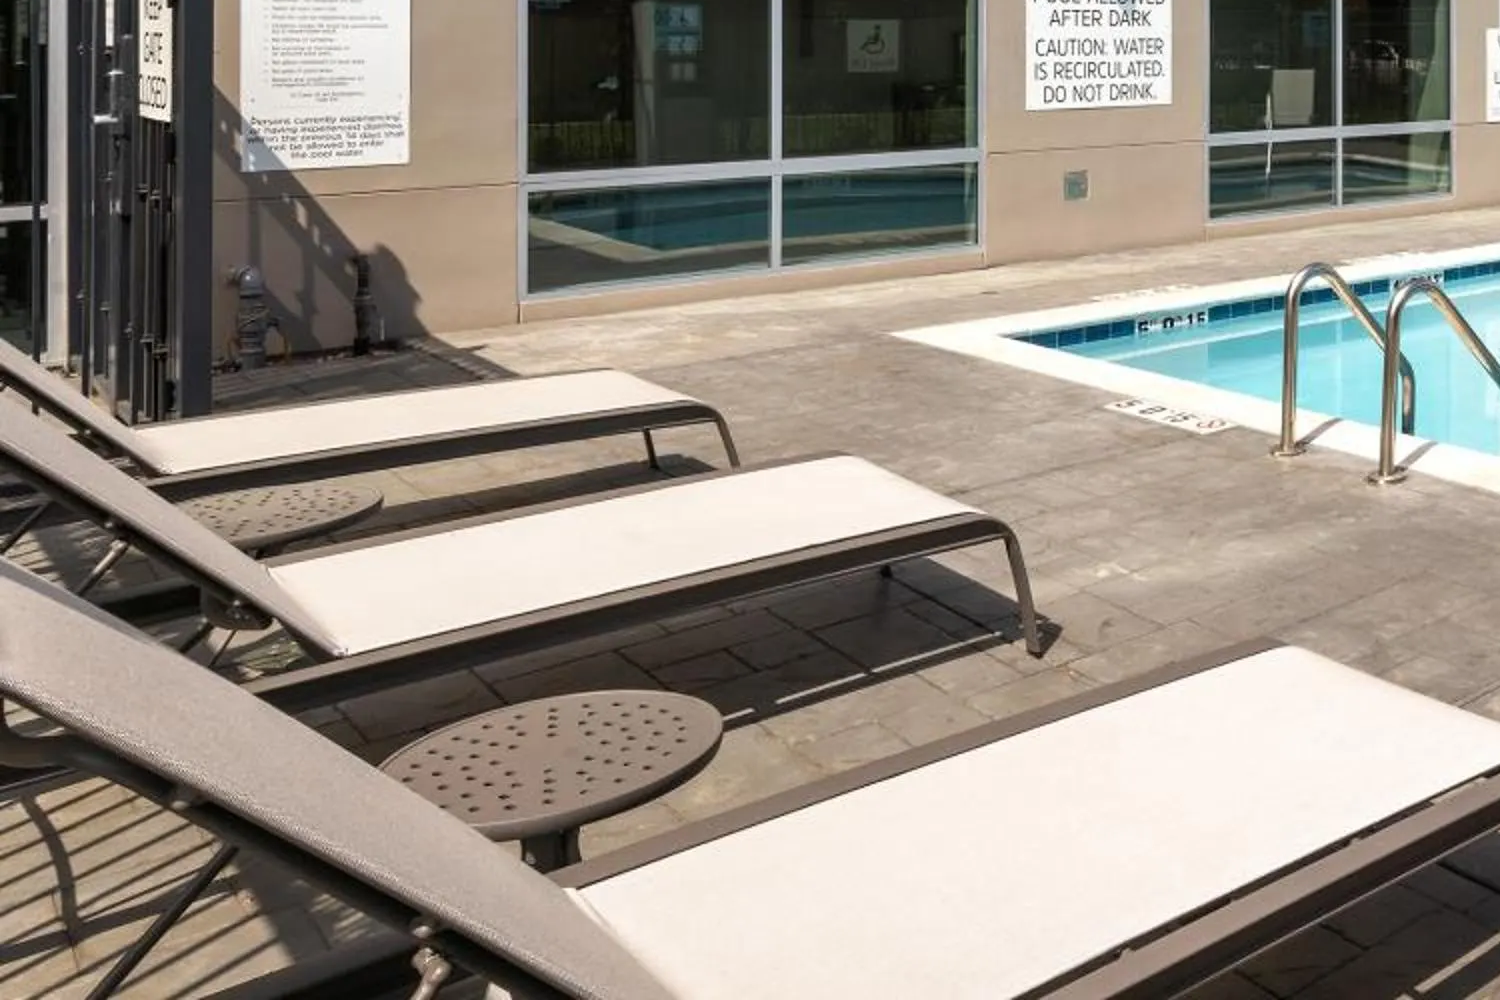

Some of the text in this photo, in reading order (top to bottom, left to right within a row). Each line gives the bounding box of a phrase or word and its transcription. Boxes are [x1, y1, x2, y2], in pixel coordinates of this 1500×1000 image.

[1049, 9, 1152, 27] AFTER DARK
[1113, 37, 1164, 55] WATER
[1034, 60, 1165, 81] IS RECIRCULATED.
[1043, 85, 1067, 104] DO
[1072, 84, 1104, 102] NOT
[251, 116, 291, 126] Persons
[294, 116, 336, 125] currently
